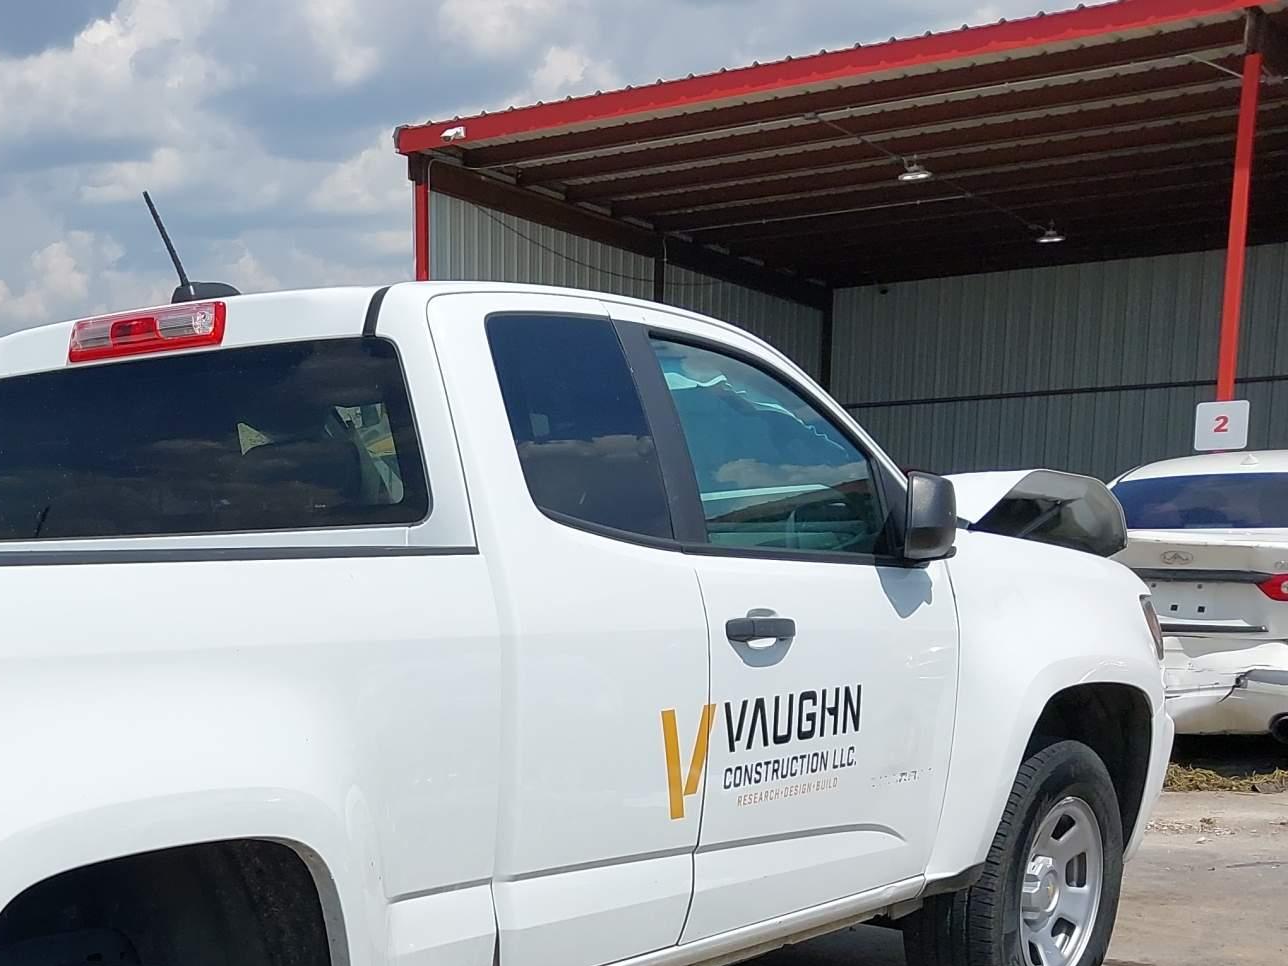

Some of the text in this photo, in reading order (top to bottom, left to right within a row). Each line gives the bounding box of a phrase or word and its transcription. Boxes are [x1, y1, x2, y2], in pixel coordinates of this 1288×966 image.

[1214, 415, 1229, 433] 2
[724, 684, 862, 753] VAUGHN
[661, 703, 717, 820] V
[723, 746, 857, 790] CONSTRUCTION LLC.
